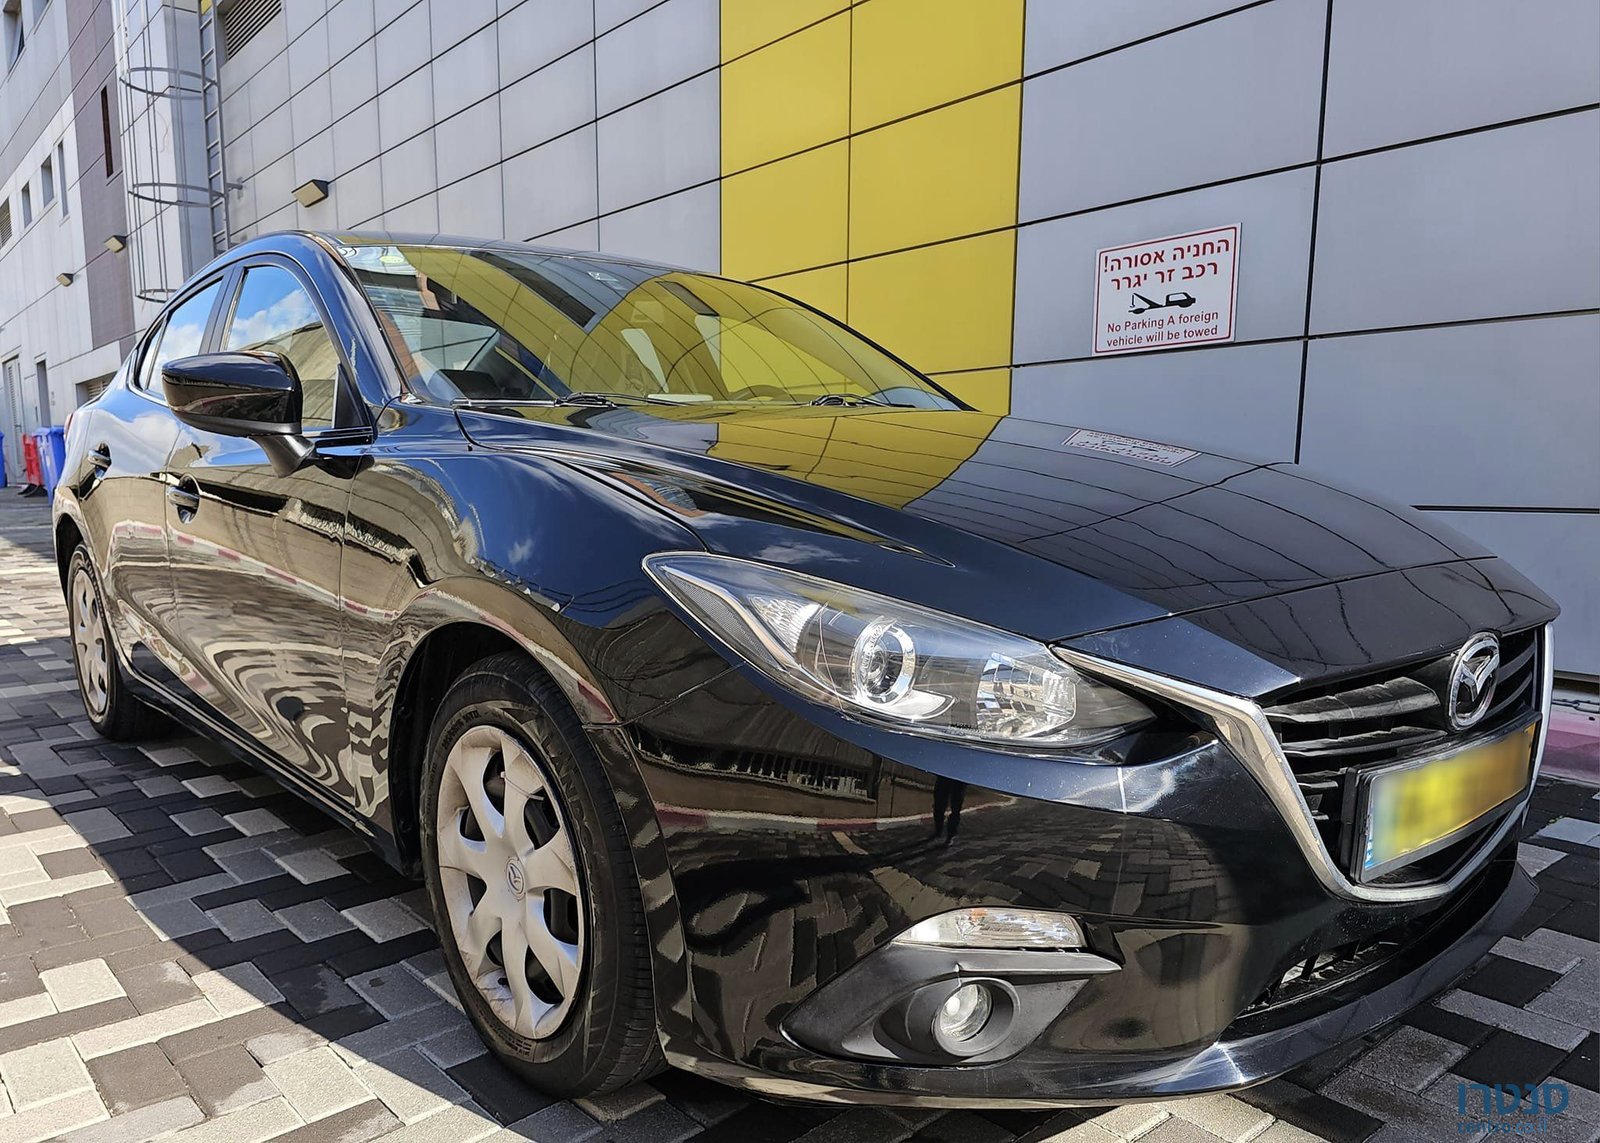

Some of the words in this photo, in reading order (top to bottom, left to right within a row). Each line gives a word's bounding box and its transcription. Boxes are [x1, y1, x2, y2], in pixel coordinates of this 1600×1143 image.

[1172, 239, 1230, 261] החניה
[1104, 250, 1165, 273] אסורה!
[1182, 262, 1218, 280] רכב
[1111, 273, 1148, 291] יגרר
[1155, 269, 1175, 283] זר
[1107, 323, 1121, 333] No
[1124, 318, 1164, 331] Parking
[1167, 315, 1176, 326] A
[1179, 311, 1219, 324] foreign
[1106, 334, 1143, 347] vehicle
[1146, 331, 1164, 343] will
[1167, 330, 1180, 340] be
[1183, 325, 1218, 339] towed
